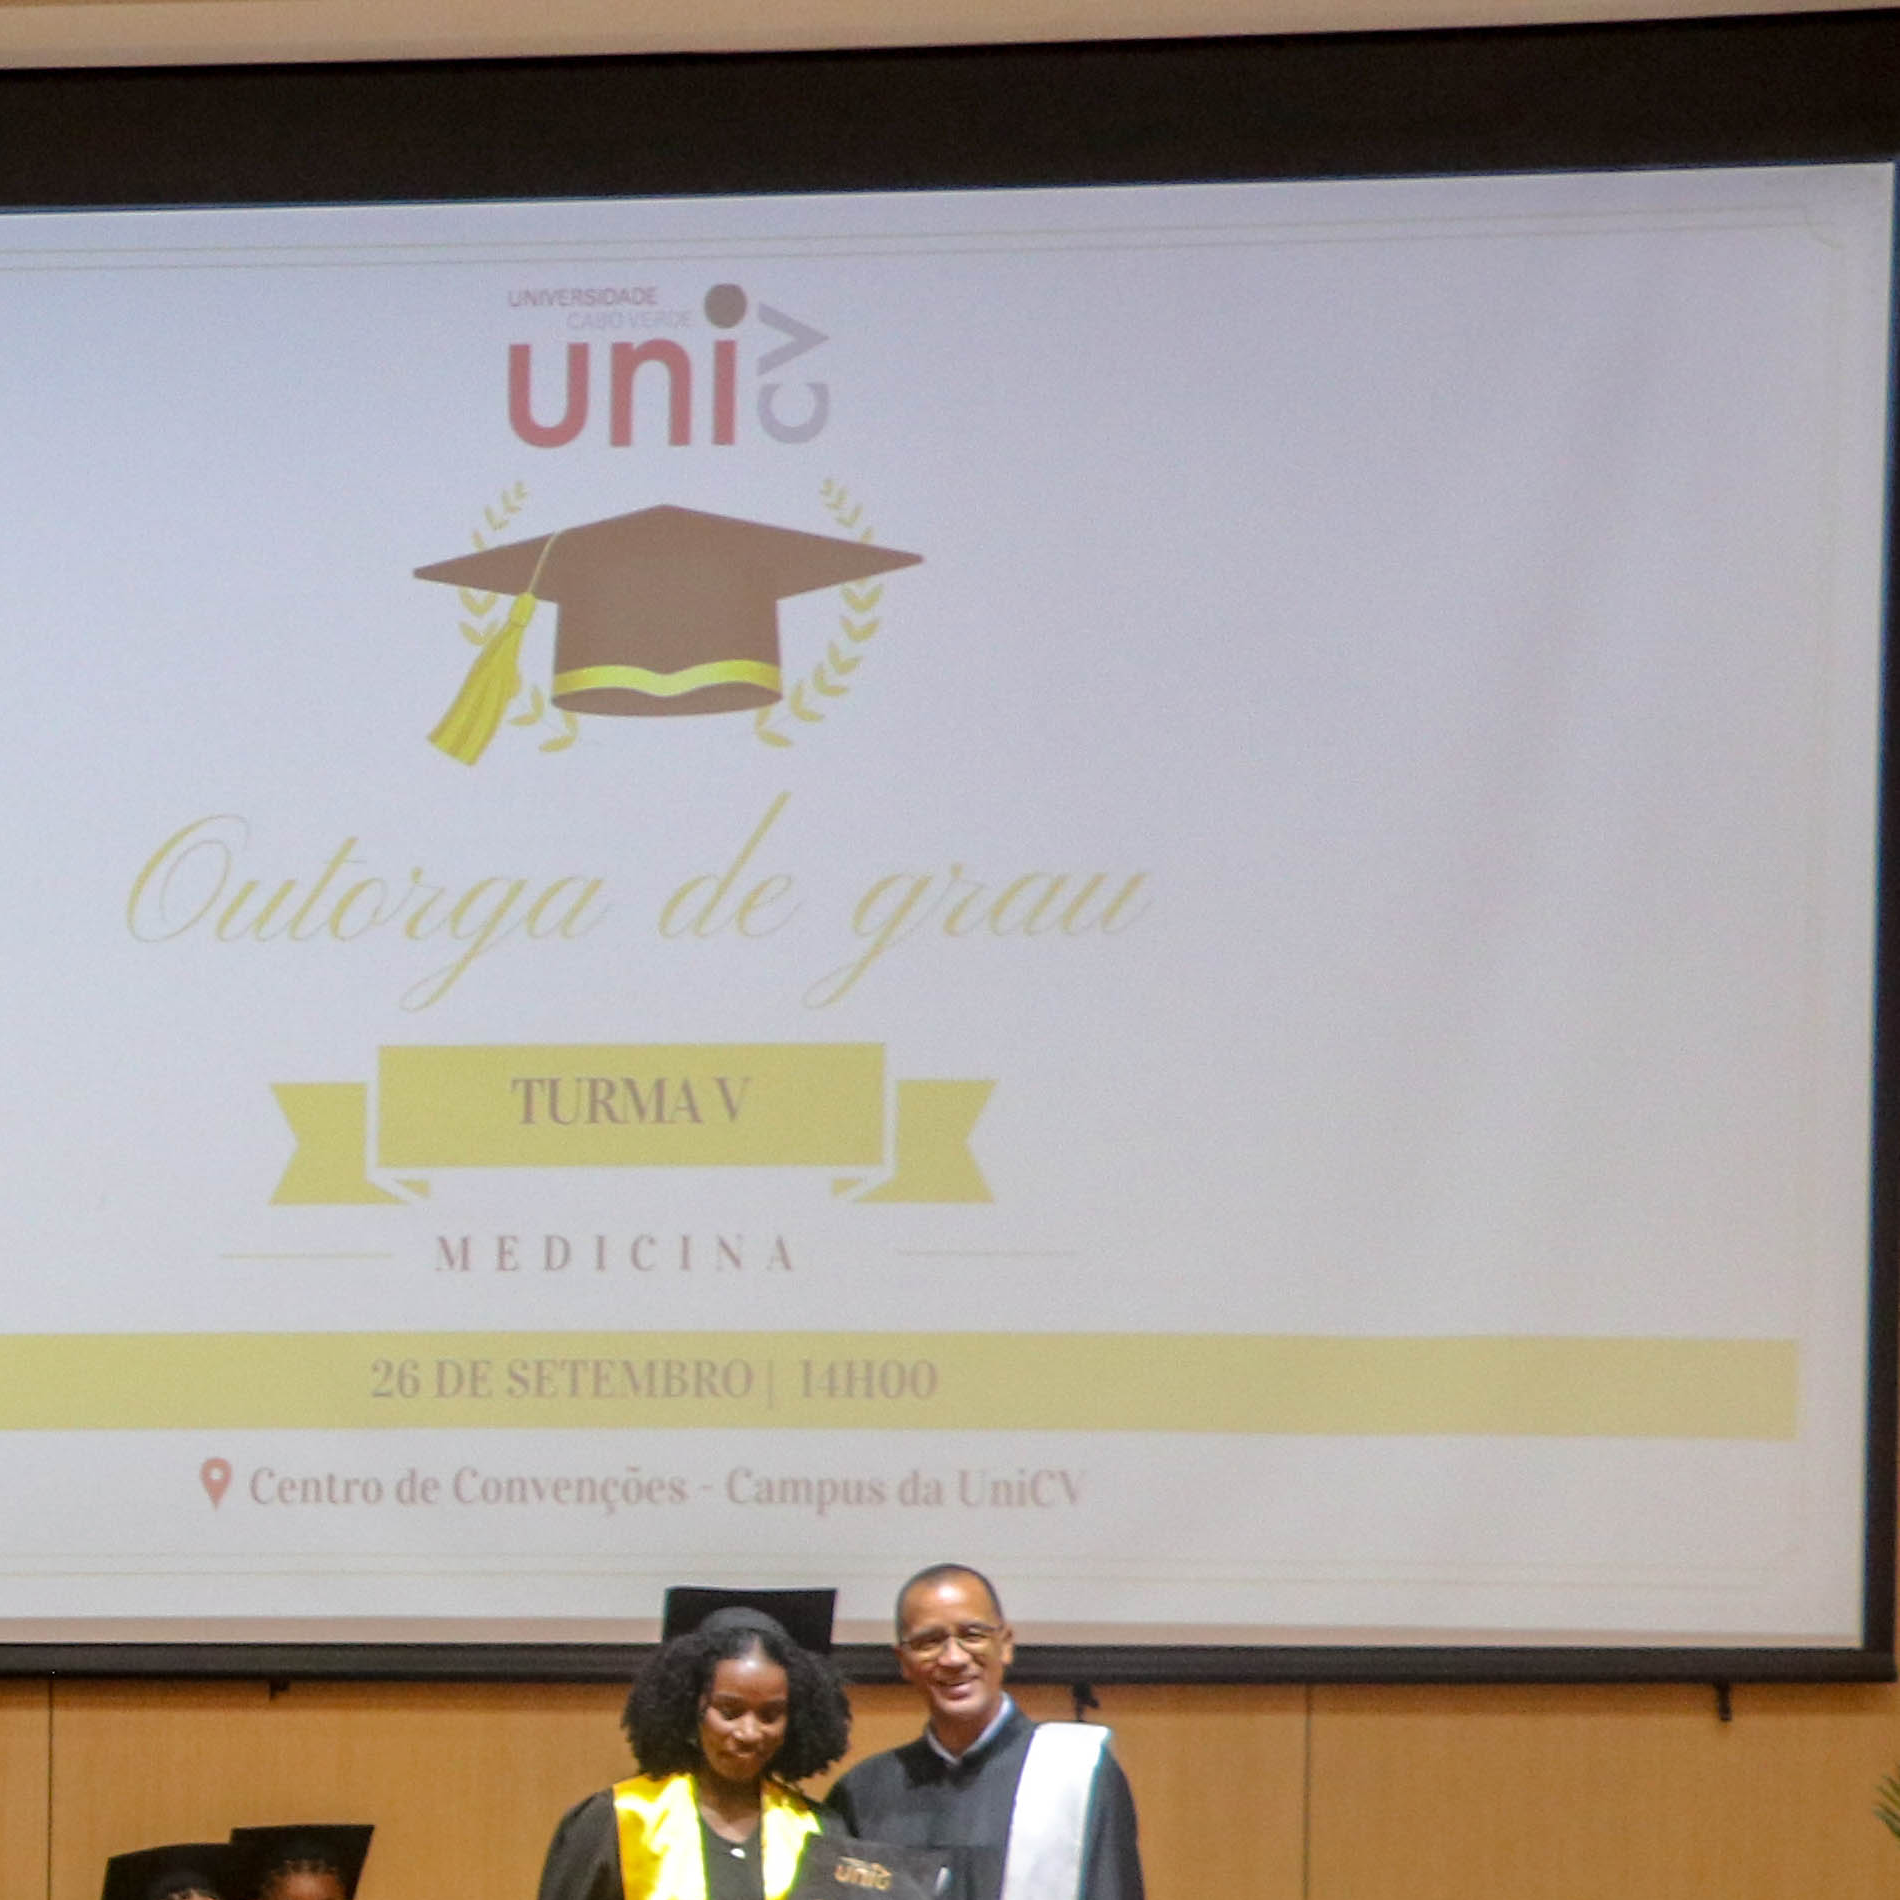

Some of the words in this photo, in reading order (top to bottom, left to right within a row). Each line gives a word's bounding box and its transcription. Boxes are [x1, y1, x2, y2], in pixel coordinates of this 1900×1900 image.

[507, 286, 658, 308] UNIVERSIDADE
[507, 283, 748, 449] uni
[124, 812, 615, 1012] Outorga
[657, 790, 796, 940] de
[802, 862, 1155, 1010] grau
[510, 1077, 697, 1126] TURMA
[700, 1075, 752, 1124] V
[435, 1234, 795, 1273] MEDICINA
[370, 1358, 421, 1399] 26
[435, 1359, 493, 1398] DE
[506, 1358, 754, 1399] SETEMBRO
[249, 1466, 384, 1505] Centro
[396, 1468, 441, 1506] de
[452, 1464, 689, 1518] Convenções
[725, 1466, 887, 1515] Campus
[898, 1470, 945, 1508] da
[957, 1468, 1086, 1508] UniCV
